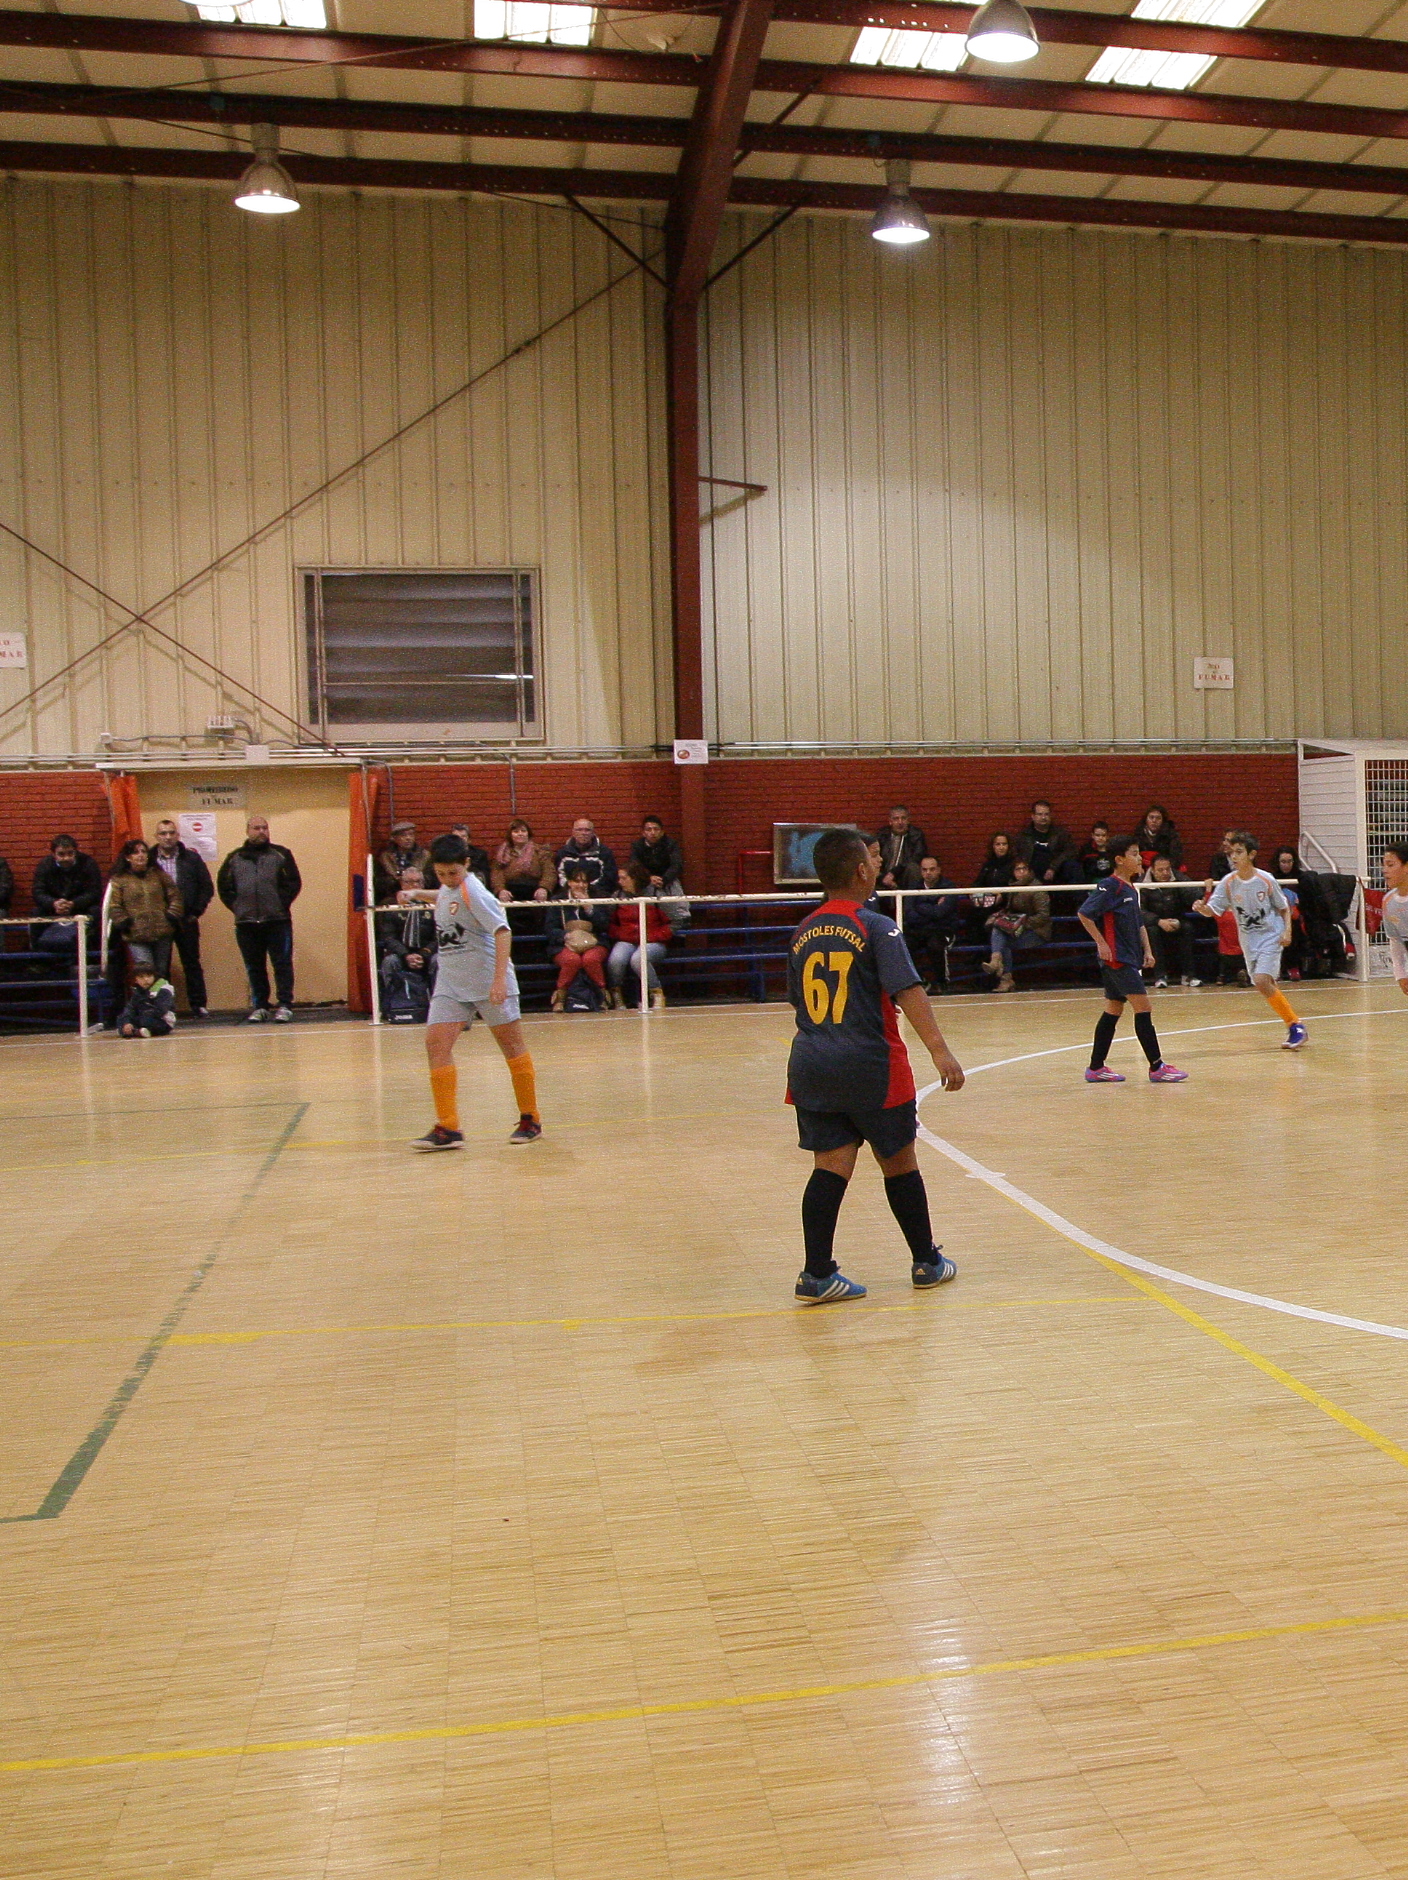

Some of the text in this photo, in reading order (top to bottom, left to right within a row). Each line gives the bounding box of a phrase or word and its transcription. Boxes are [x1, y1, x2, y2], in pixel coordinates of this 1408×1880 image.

[792, 925, 866, 955] MOSTOLES FUTSAL
[802, 951, 854, 1025] 67
